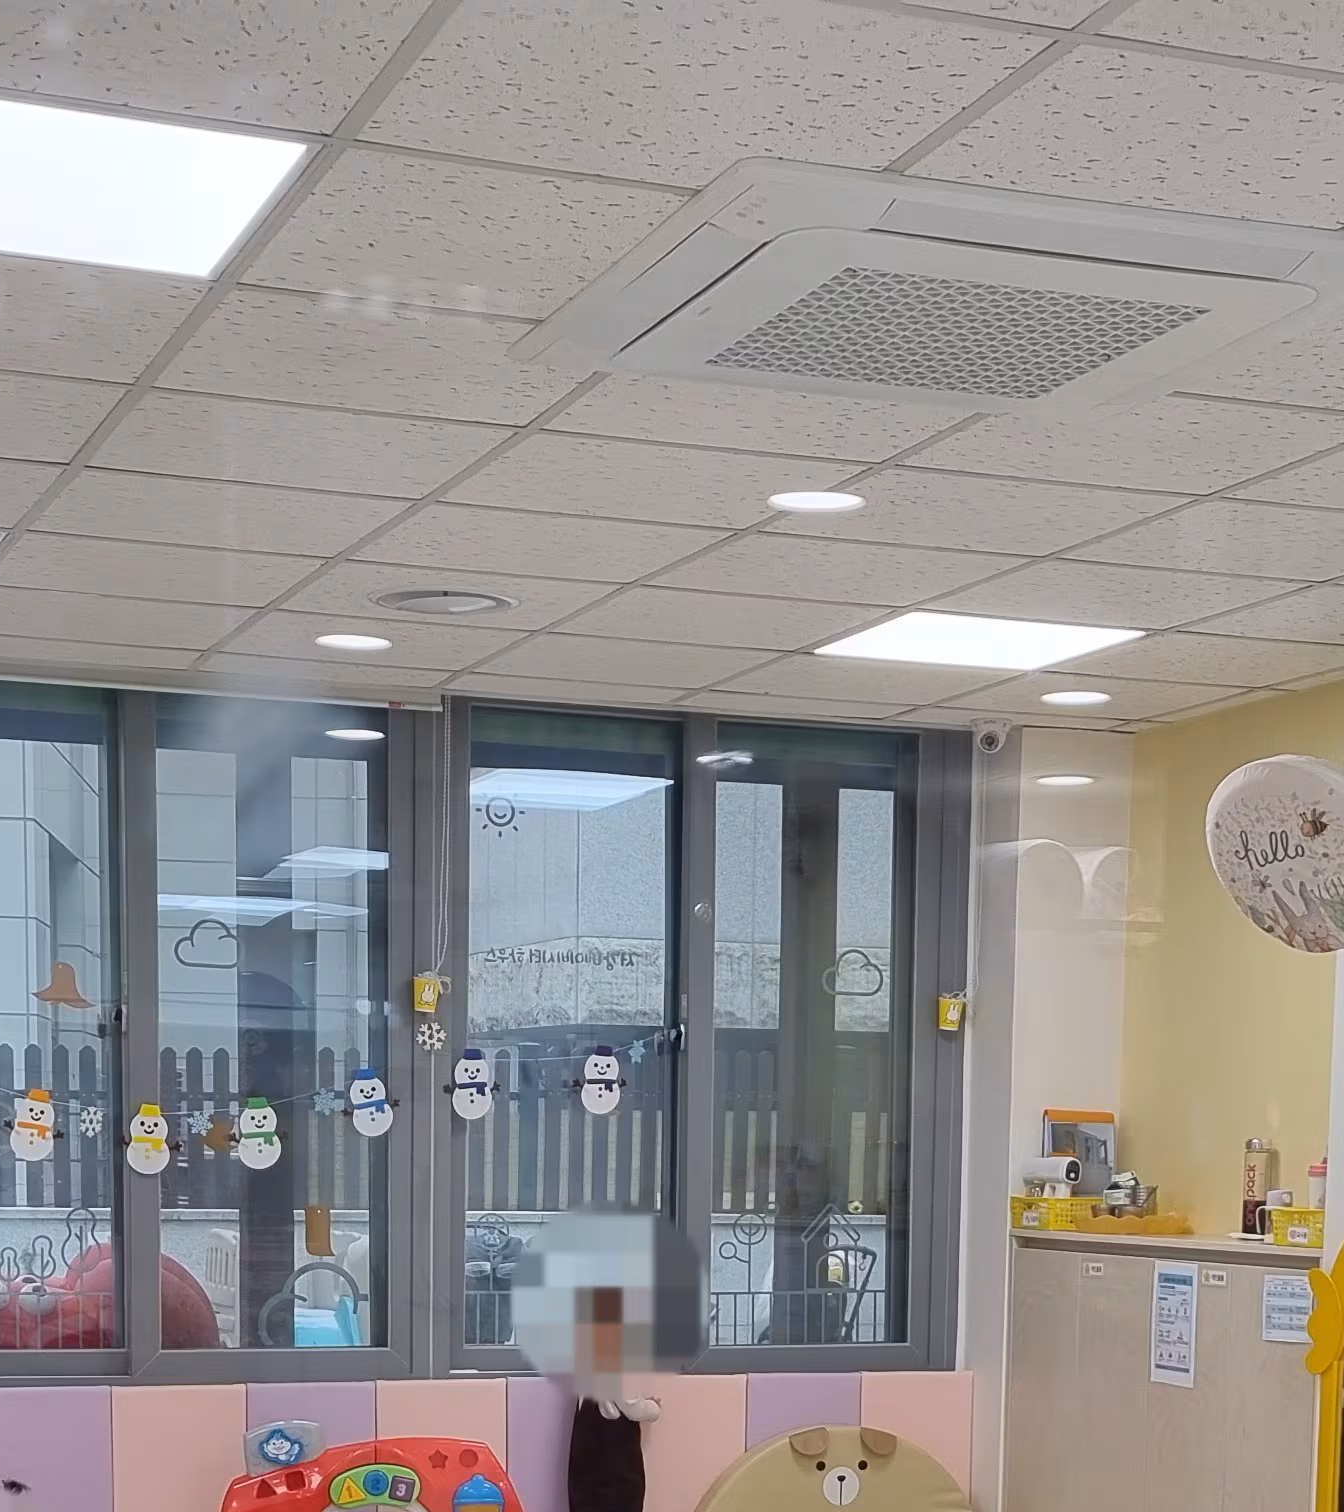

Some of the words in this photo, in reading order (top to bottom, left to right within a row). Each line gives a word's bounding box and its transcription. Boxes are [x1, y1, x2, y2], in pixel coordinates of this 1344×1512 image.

[1235, 830, 1305, 871] hello
[370, 1478, 380, 1491] 2
[395, 1483, 407, 1497] 3
